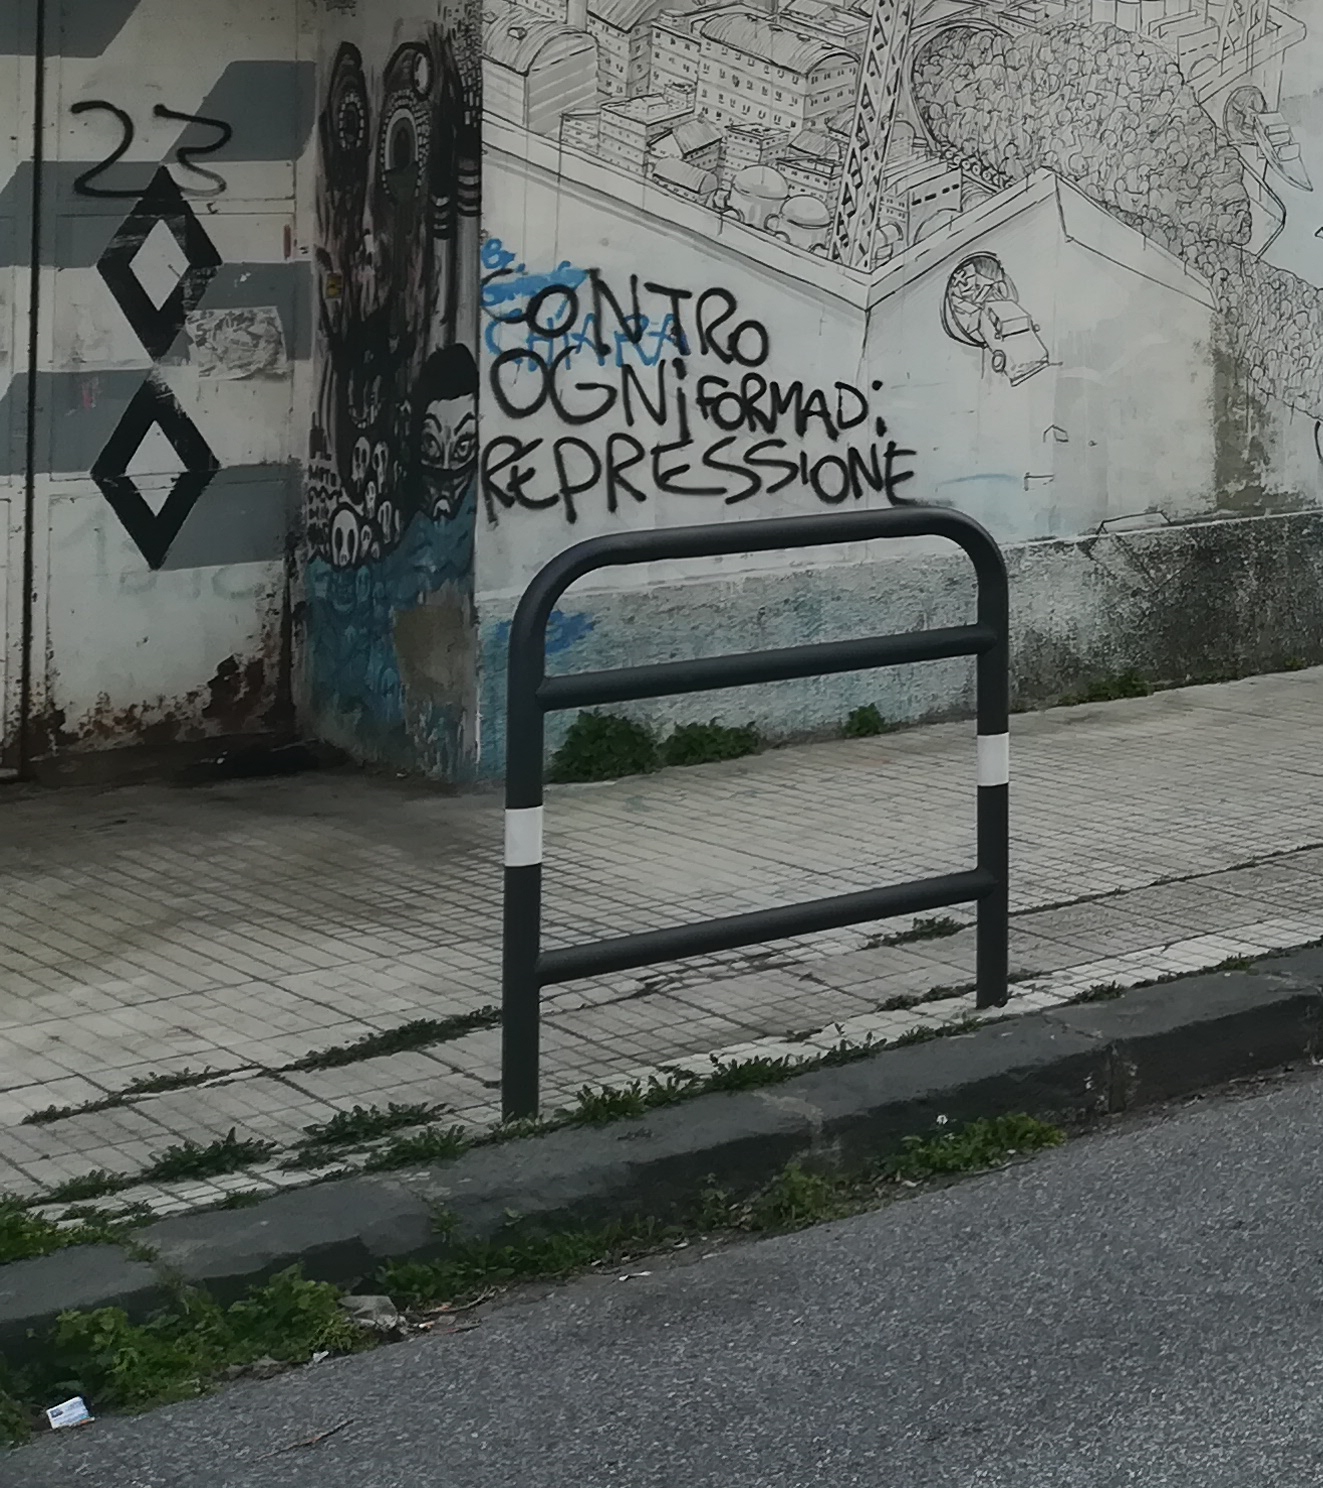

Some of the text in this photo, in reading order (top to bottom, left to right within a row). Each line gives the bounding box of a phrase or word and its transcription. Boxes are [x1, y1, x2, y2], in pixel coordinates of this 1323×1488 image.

[70, 99, 233, 200] 23
[480, 267, 769, 367] CONTRO
[481, 434, 918, 526] REPRESSIONE
